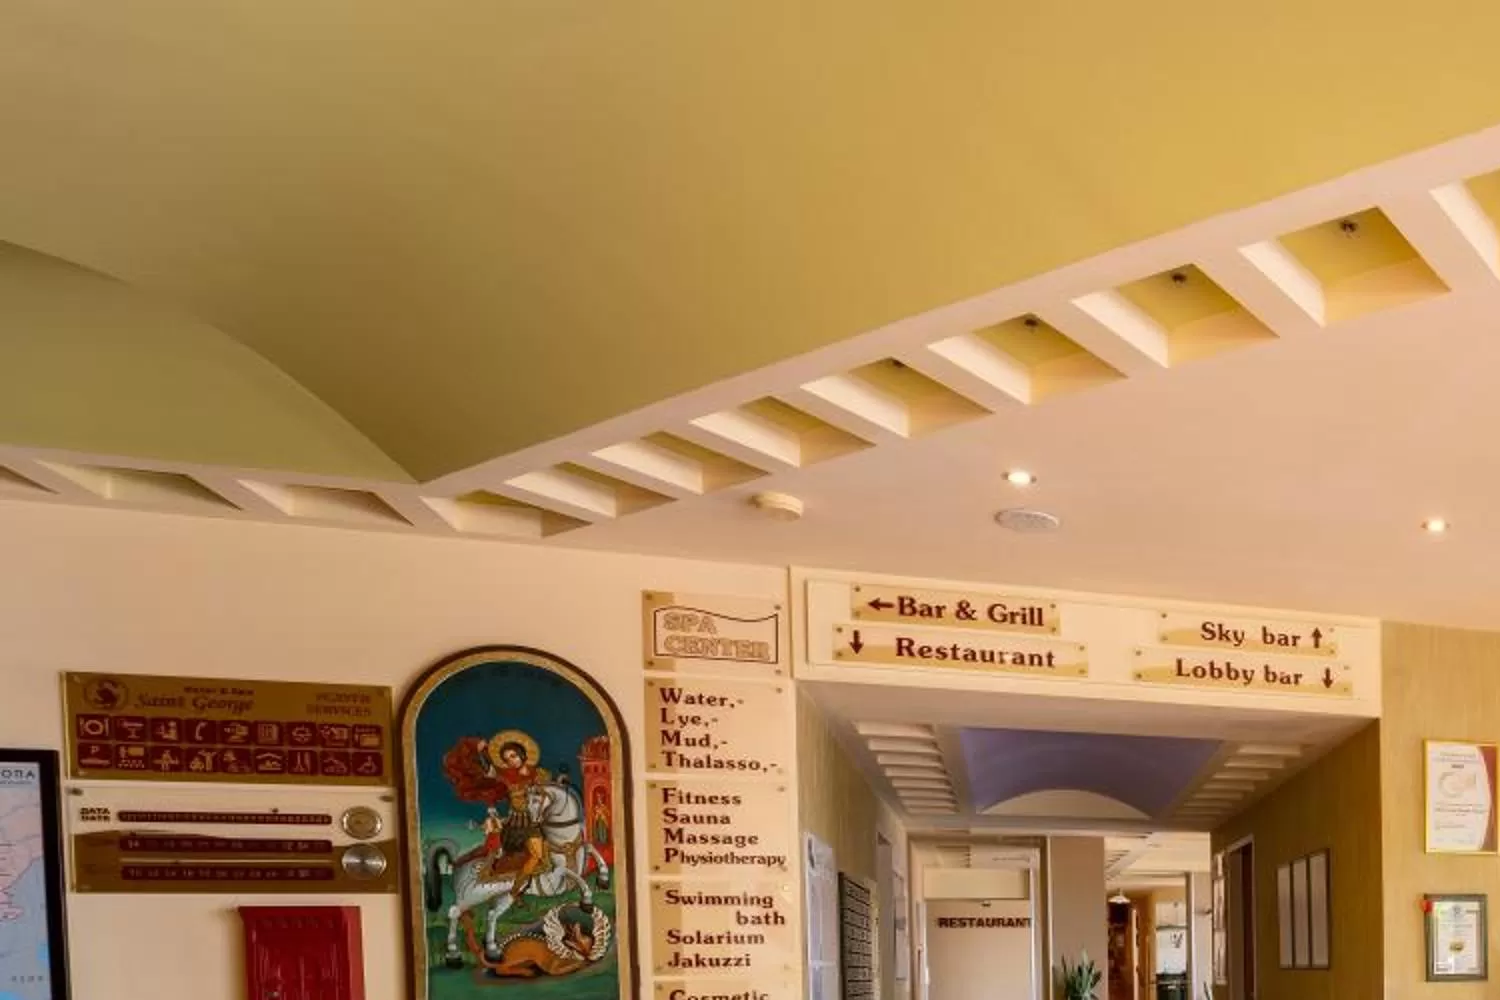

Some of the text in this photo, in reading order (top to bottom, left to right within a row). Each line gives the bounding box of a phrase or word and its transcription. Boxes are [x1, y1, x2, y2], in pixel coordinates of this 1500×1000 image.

[897, 595, 1045, 627] Bar & Grill
[662, 611, 718, 635] SPA
[1200, 621, 1303, 647] Sky bar
[662, 635, 771, 661] CENTER
[895, 636, 1056, 669] Restaurant
[1175, 657, 1303, 686] Lobby bar
[134, 691, 256, 715] Saint George
[661, 787, 742, 805] Fitness
[662, 807, 731, 824] Sauna
[663, 827, 759, 848] Massage
[664, 847, 786, 868] Physiotherapy
[665, 889, 774, 909] Swimming
[736, 910, 785, 925] bath
[937, 916, 1032, 929] RESTAURANT
[666, 928, 765, 945] Solarium
[667, 951, 752, 968] Jakuzzi
